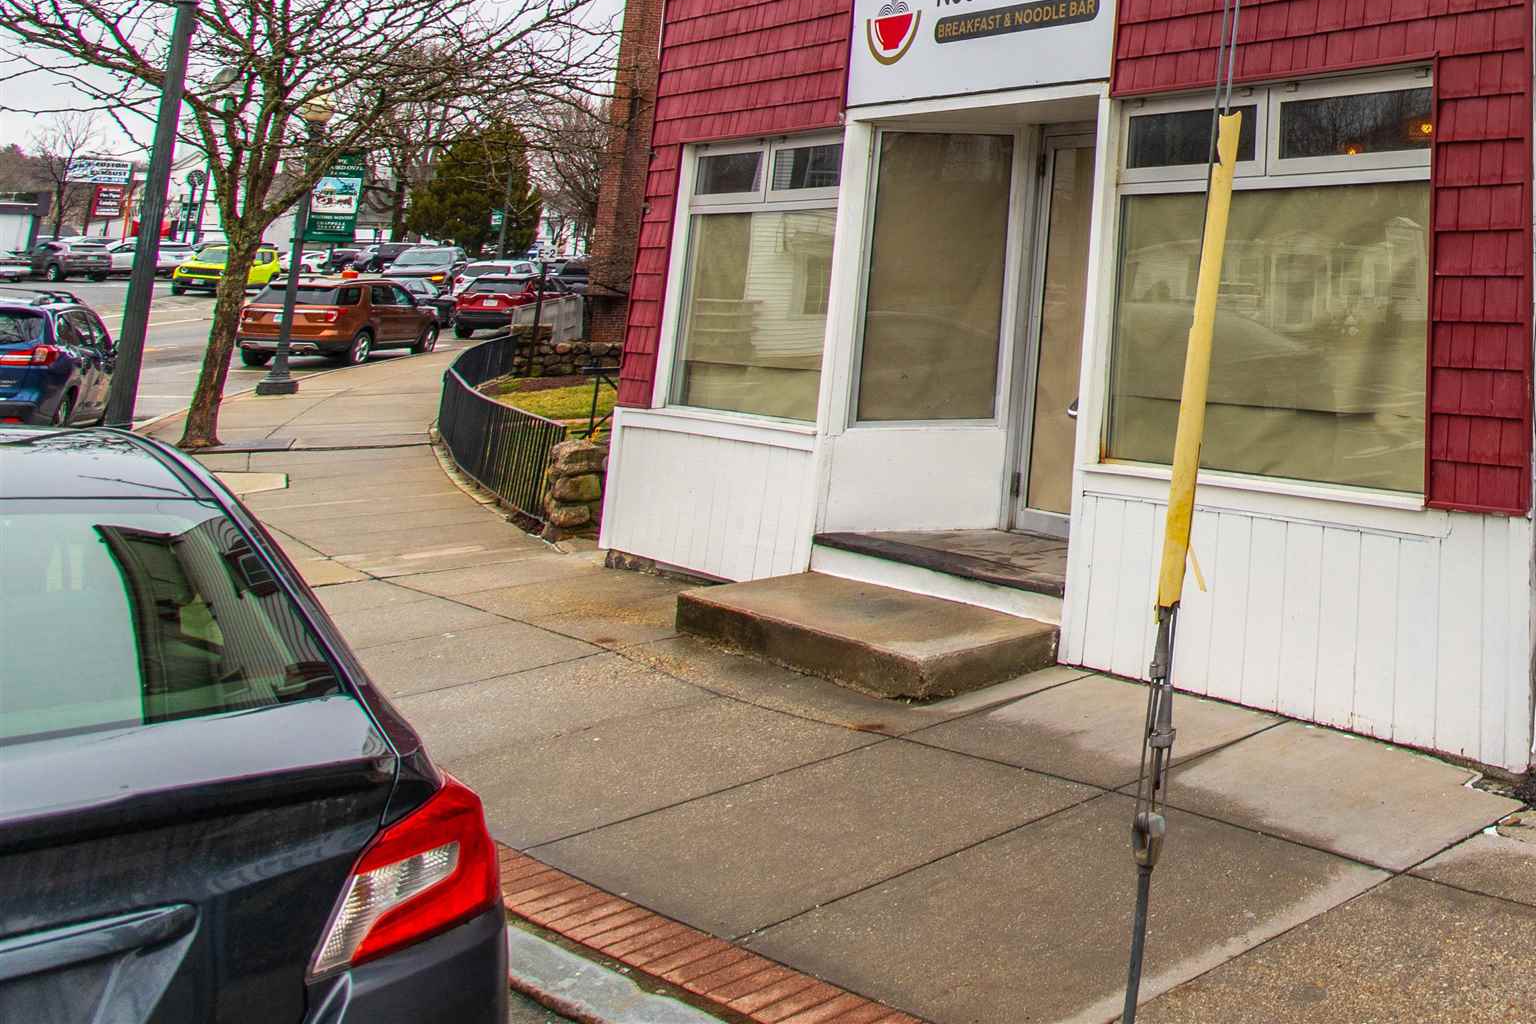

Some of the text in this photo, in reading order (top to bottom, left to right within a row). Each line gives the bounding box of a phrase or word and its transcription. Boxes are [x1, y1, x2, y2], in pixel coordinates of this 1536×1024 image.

[937, 13, 1001, 39] BREAKFAST
[1003, 12, 1012, 27] &
[1014, 1, 1067, 26] NOODLE
[539, 249, 556, 258] E-2
